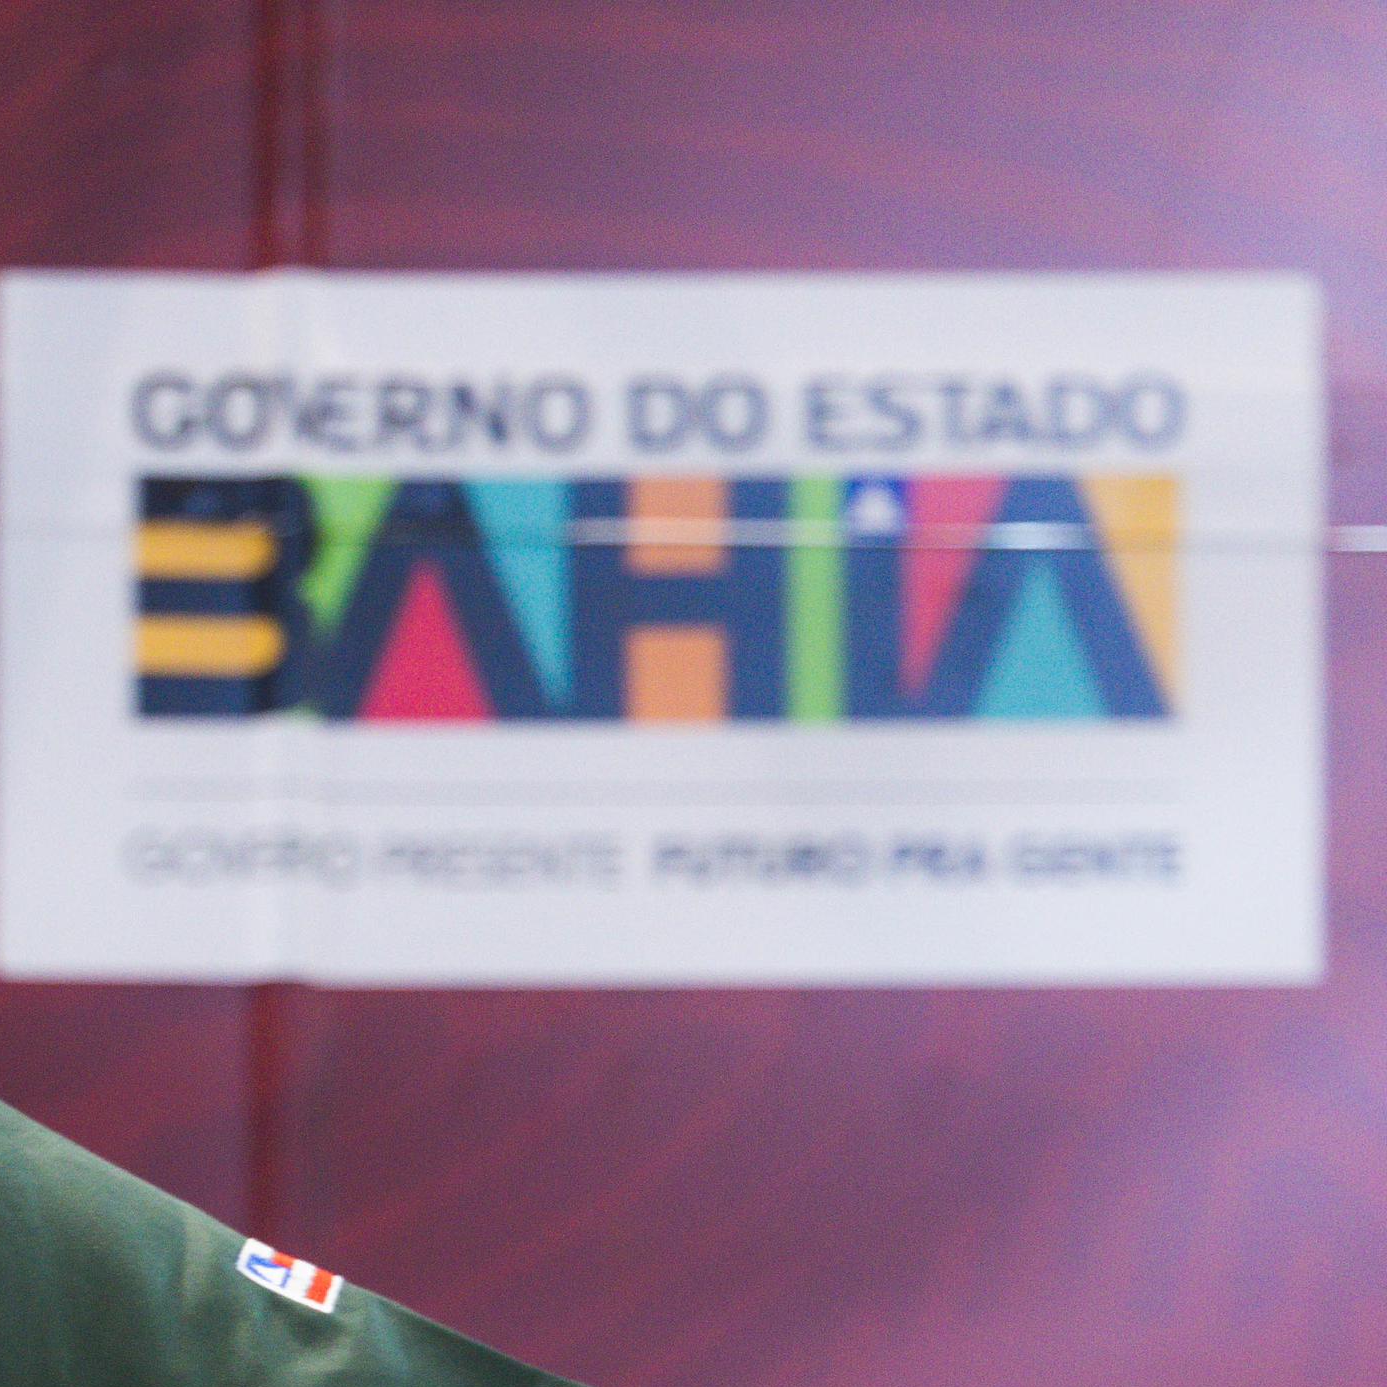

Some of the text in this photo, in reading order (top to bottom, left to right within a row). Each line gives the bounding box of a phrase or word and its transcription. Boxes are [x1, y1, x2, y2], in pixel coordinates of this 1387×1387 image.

[130, 370, 1188, 453] GOVERNO DO ESTADO
[135, 472, 1179, 719] BAHIA
[654, 828, 870, 888] FUTURO
